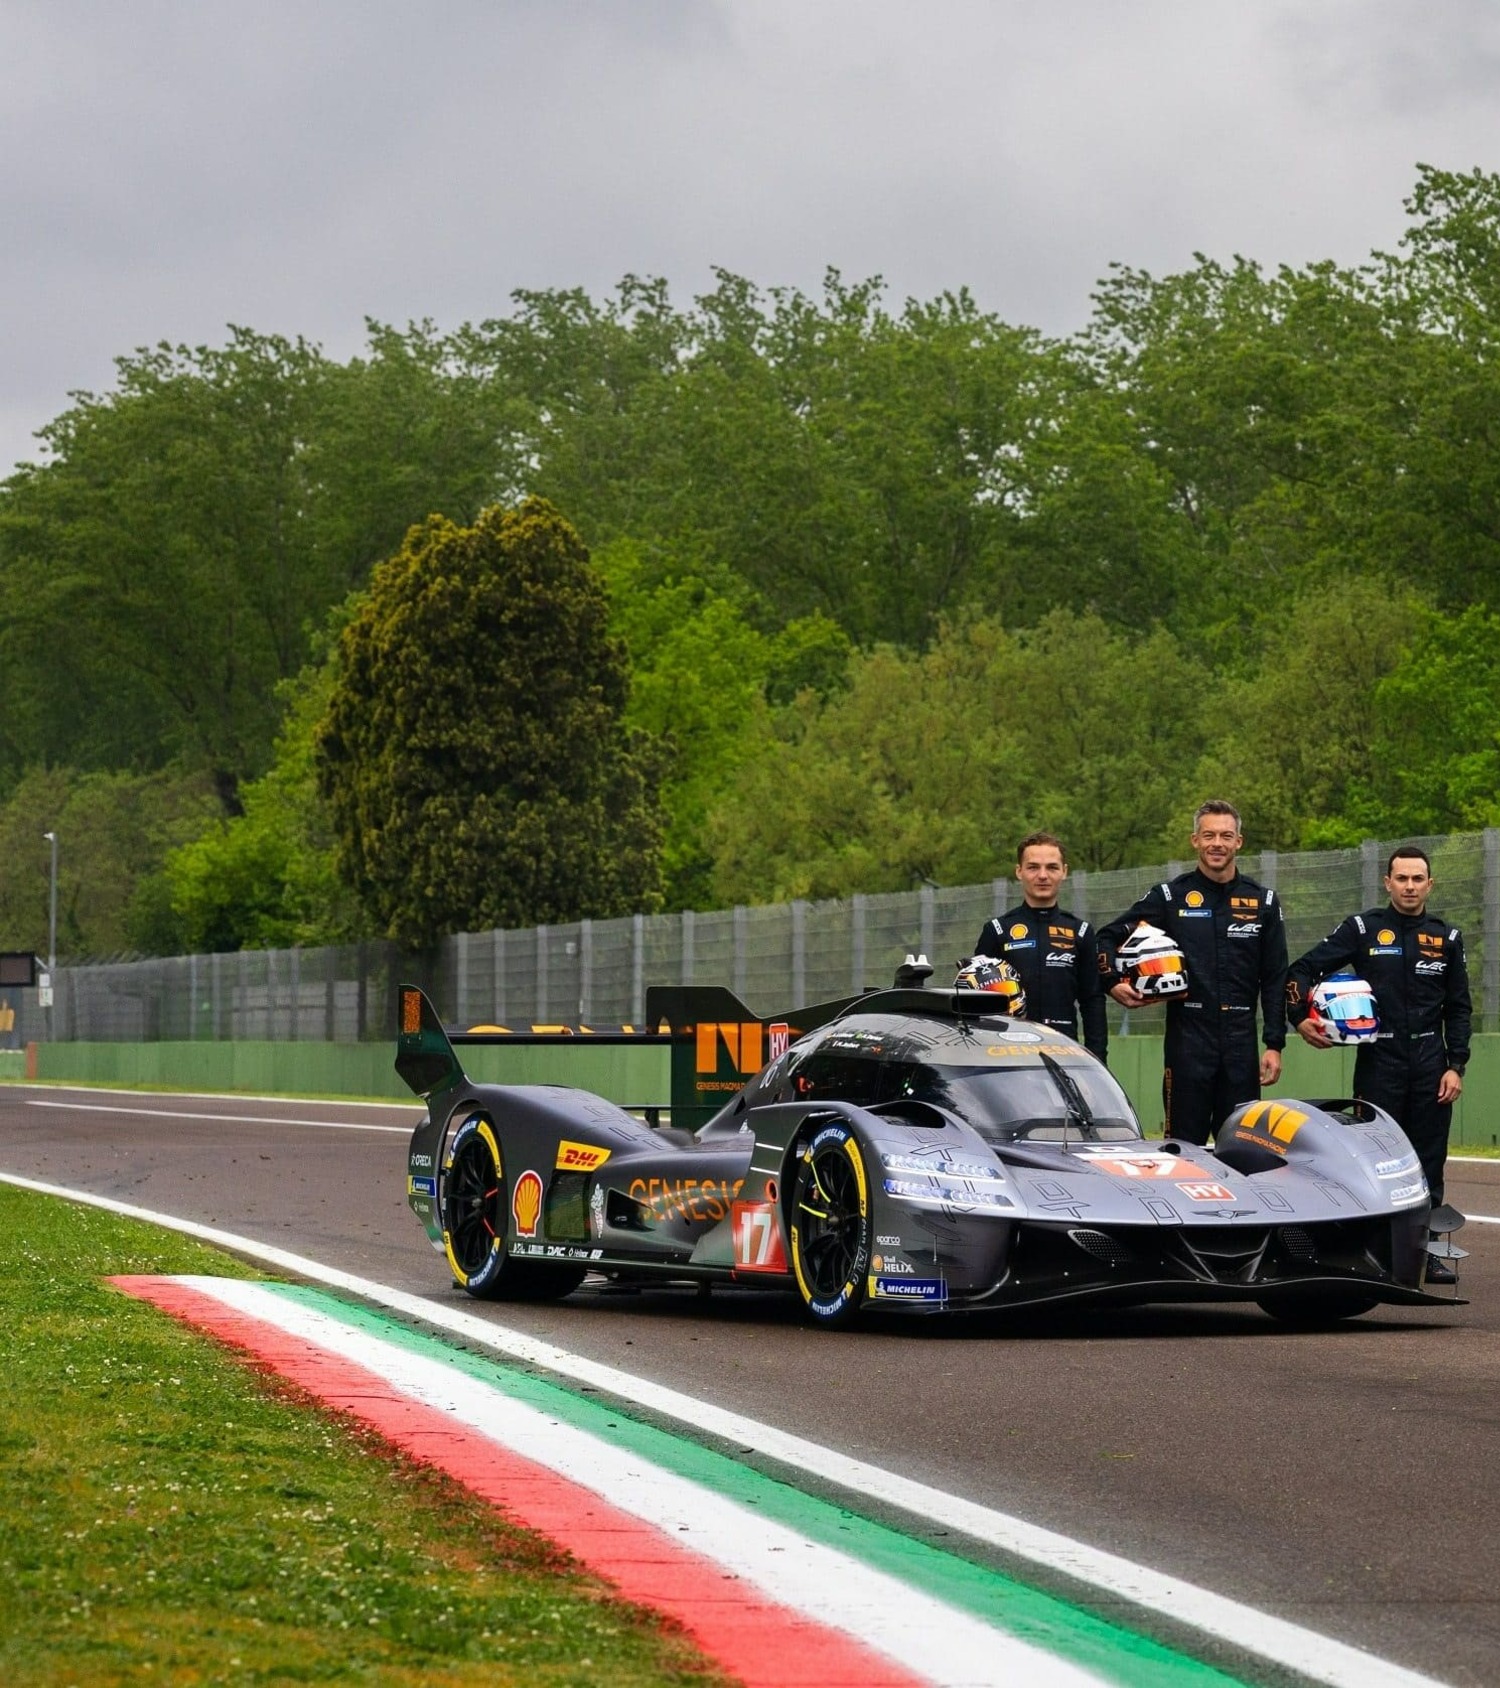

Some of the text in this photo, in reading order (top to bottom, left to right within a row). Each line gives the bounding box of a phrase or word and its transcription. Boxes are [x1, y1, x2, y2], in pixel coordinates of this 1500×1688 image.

[1227, 923, 1262, 933] WEC
[1046, 952, 1077, 963] WEC
[1415, 960, 1447, 971] WEC
[987, 1045, 1085, 1056] GENESIS
[814, 1127, 846, 1145] MICHELIN
[564, 1149, 600, 1167] DHL
[1112, 1161, 1178, 1176] 17
[1183, 1183, 1225, 1198] HY
[741, 1212, 771, 1264] 17
[884, 1261, 915, 1273] HELIX
[887, 1285, 935, 1294] MICHELIN
[812, 1297, 842, 1315] MICHELIN
